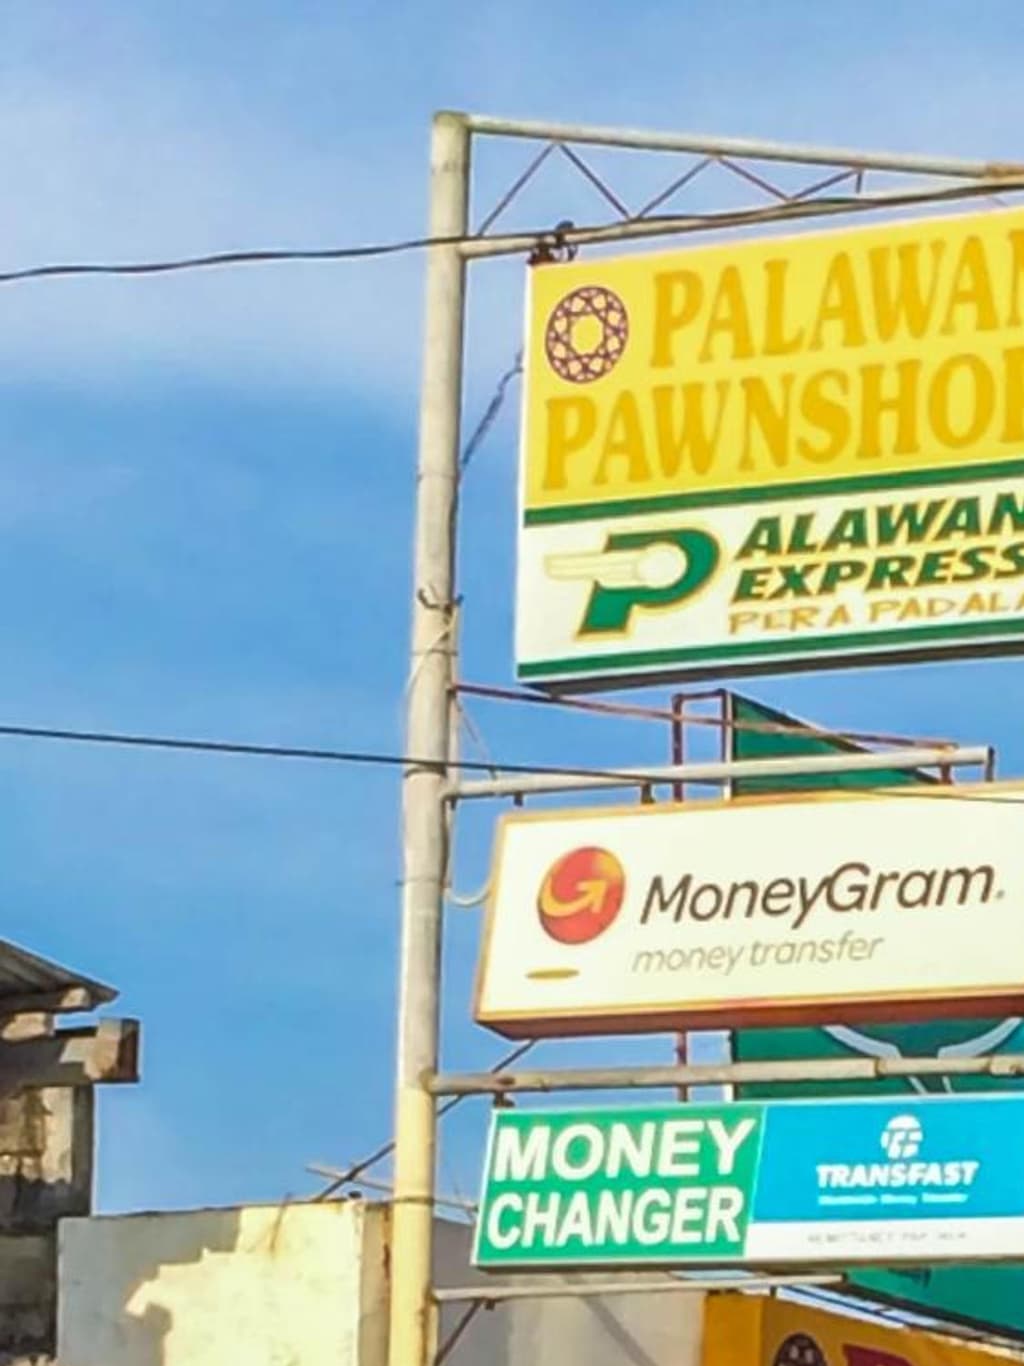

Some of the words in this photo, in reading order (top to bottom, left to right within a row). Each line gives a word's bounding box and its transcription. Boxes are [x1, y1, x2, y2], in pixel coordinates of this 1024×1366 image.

[728, 605, 852, 636] PERA
[639, 862, 997, 929] MoneyGram
[631, 942, 744, 976] money
[750, 932, 884, 968] transfer
[493, 1119, 756, 1182] MONEY
[815, 1161, 980, 1189] TRANSFAST
[487, 1187, 744, 1249] CHANGER
